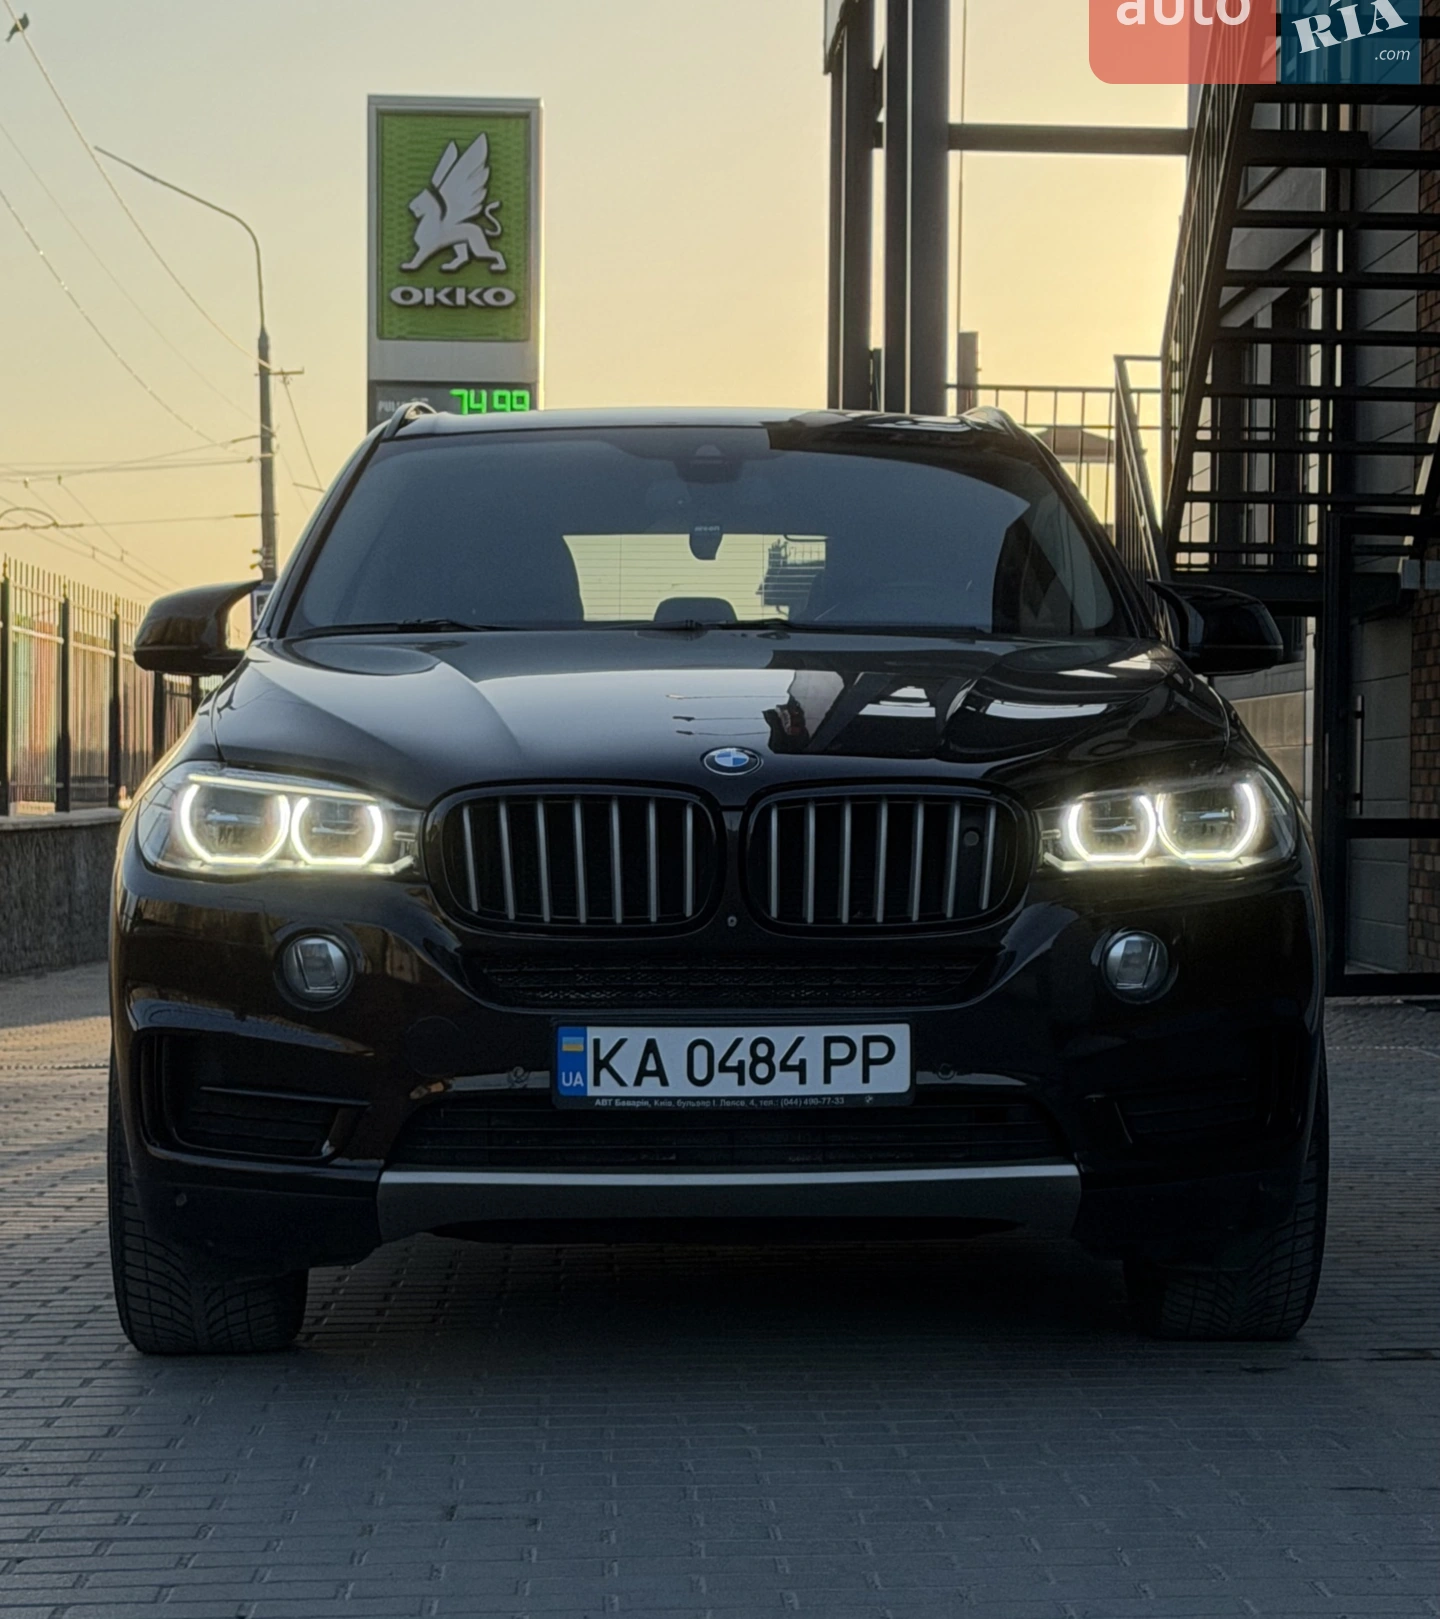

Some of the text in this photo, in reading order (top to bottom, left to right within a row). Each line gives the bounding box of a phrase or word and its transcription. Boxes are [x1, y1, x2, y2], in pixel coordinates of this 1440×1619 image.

[389, 285, 517, 307] OKKO
[592, 1034, 897, 1088] KA 0484 PP
[561, 1071, 584, 1087] UA
